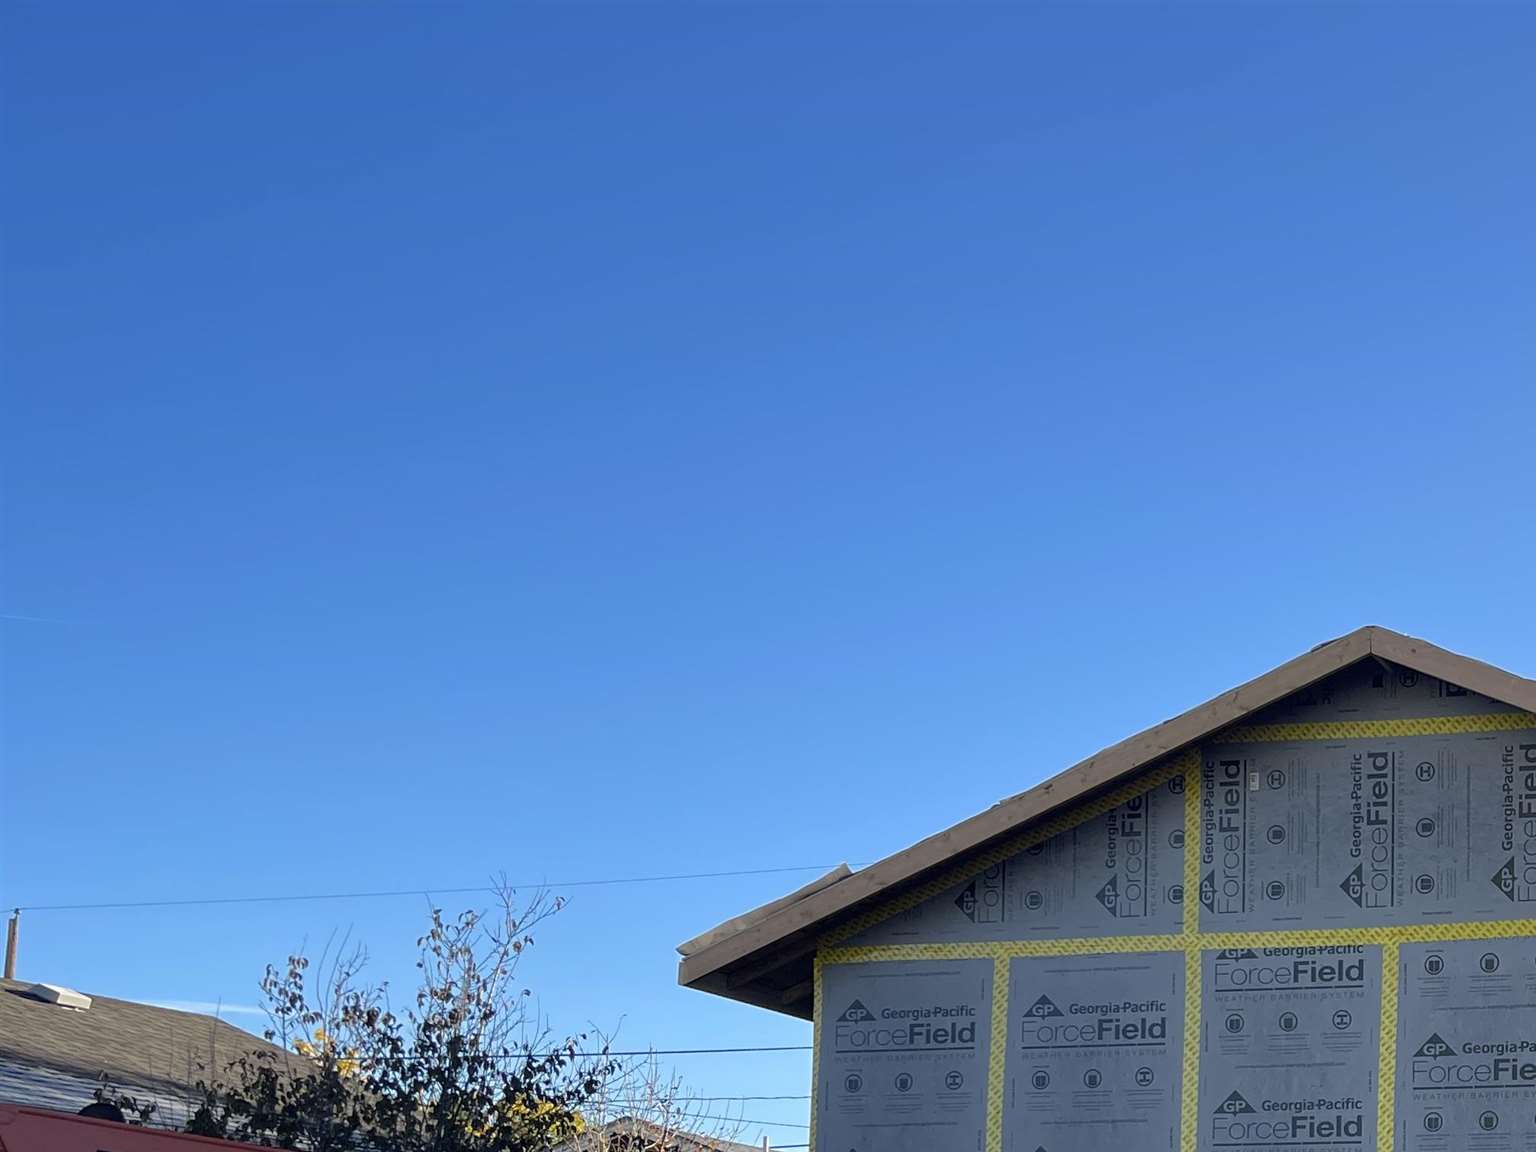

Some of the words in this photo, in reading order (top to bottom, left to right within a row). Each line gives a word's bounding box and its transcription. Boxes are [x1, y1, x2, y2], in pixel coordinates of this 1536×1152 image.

[1350, 753, 1364, 858] Georgia-Pacific
[1502, 745, 1516, 851] Georgia-Pacific
[1203, 760, 1216, 864] Georgia-Pacific
[1218, 759, 1240, 914] ForceField
[1366, 752, 1388, 909] ForceField
[1214, 960, 1364, 986] ForceField
[881, 1005, 976, 1020] Georgia-Pacific
[1069, 1000, 1167, 1017] Georgia-Pacific
[835, 1022, 976, 1047] ForceField
[1021, 1017, 1167, 1043] ForceField
[1261, 1098, 1363, 1114] Georgia-Pacific
[1212, 1115, 1363, 1139] ForceField
